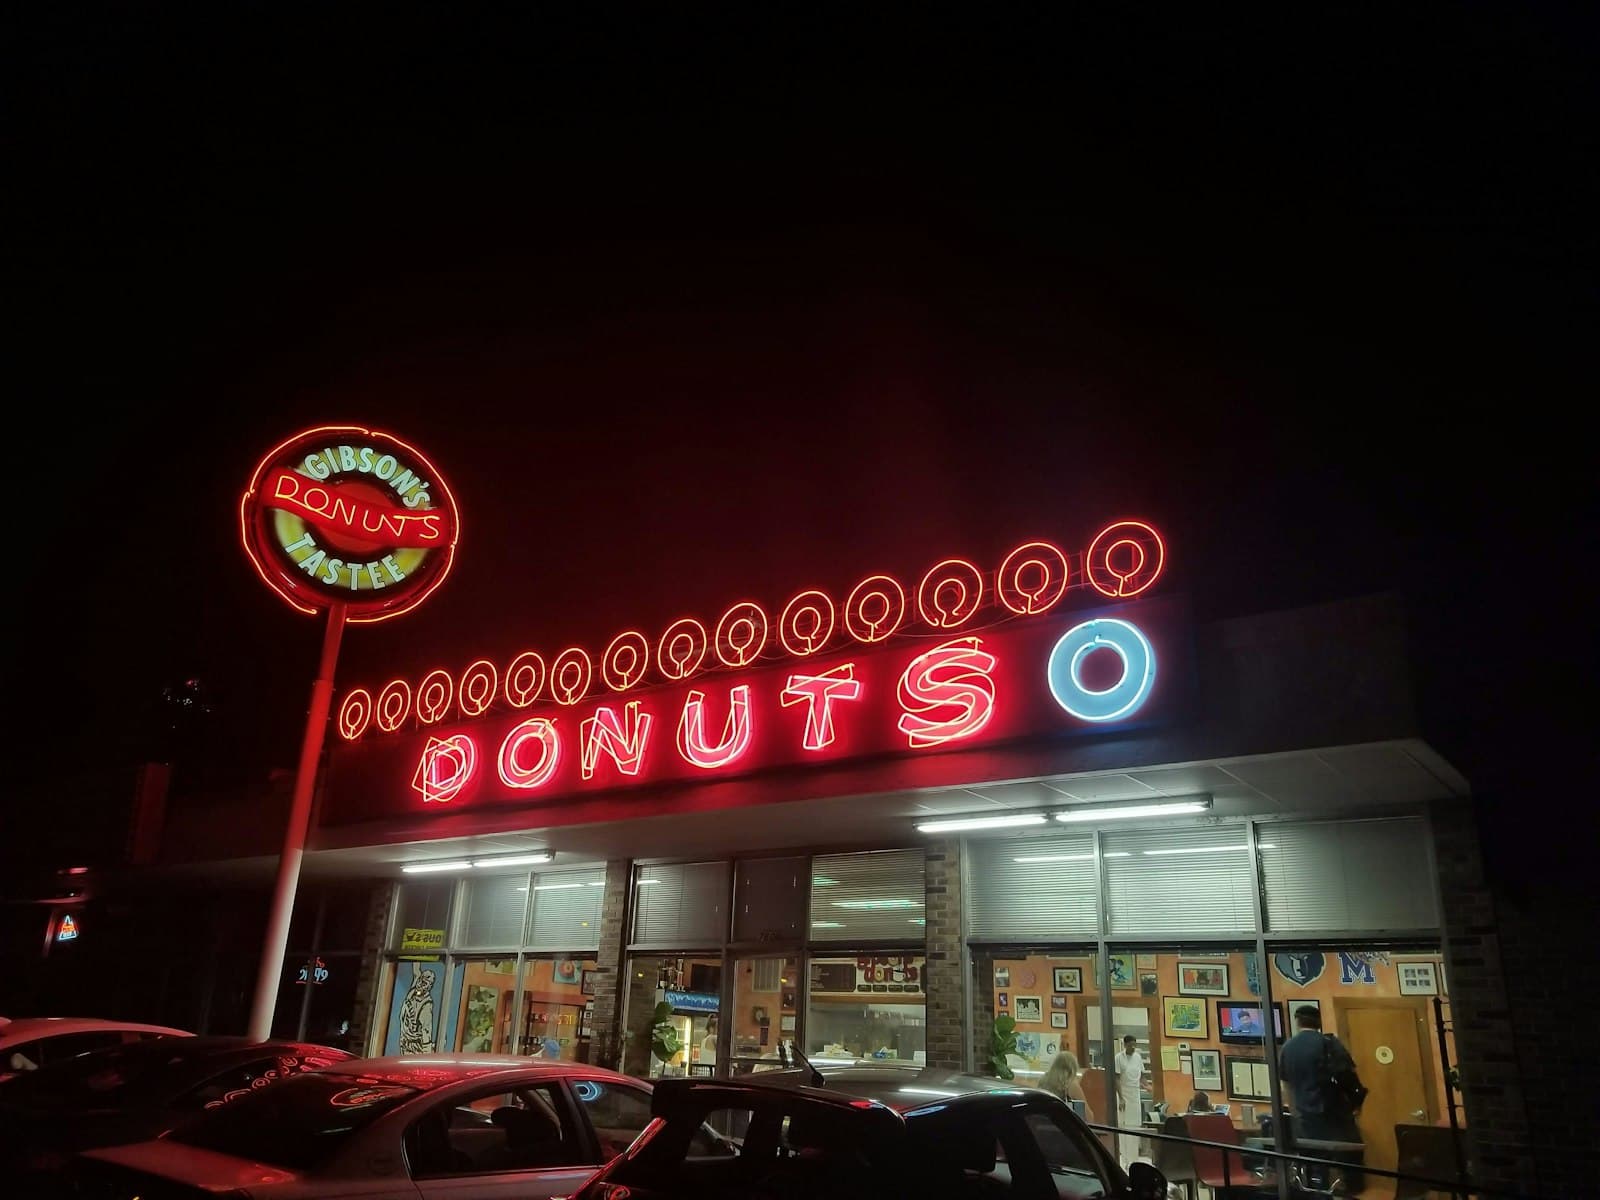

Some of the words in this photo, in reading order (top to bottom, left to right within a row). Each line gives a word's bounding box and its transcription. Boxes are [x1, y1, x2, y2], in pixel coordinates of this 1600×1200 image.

[274, 475, 440, 539] DONUTS
[304, 445, 431, 508] GIBSON'S
[284, 532, 406, 591] TASTEE
[411, 636, 998, 802] DONUTS
